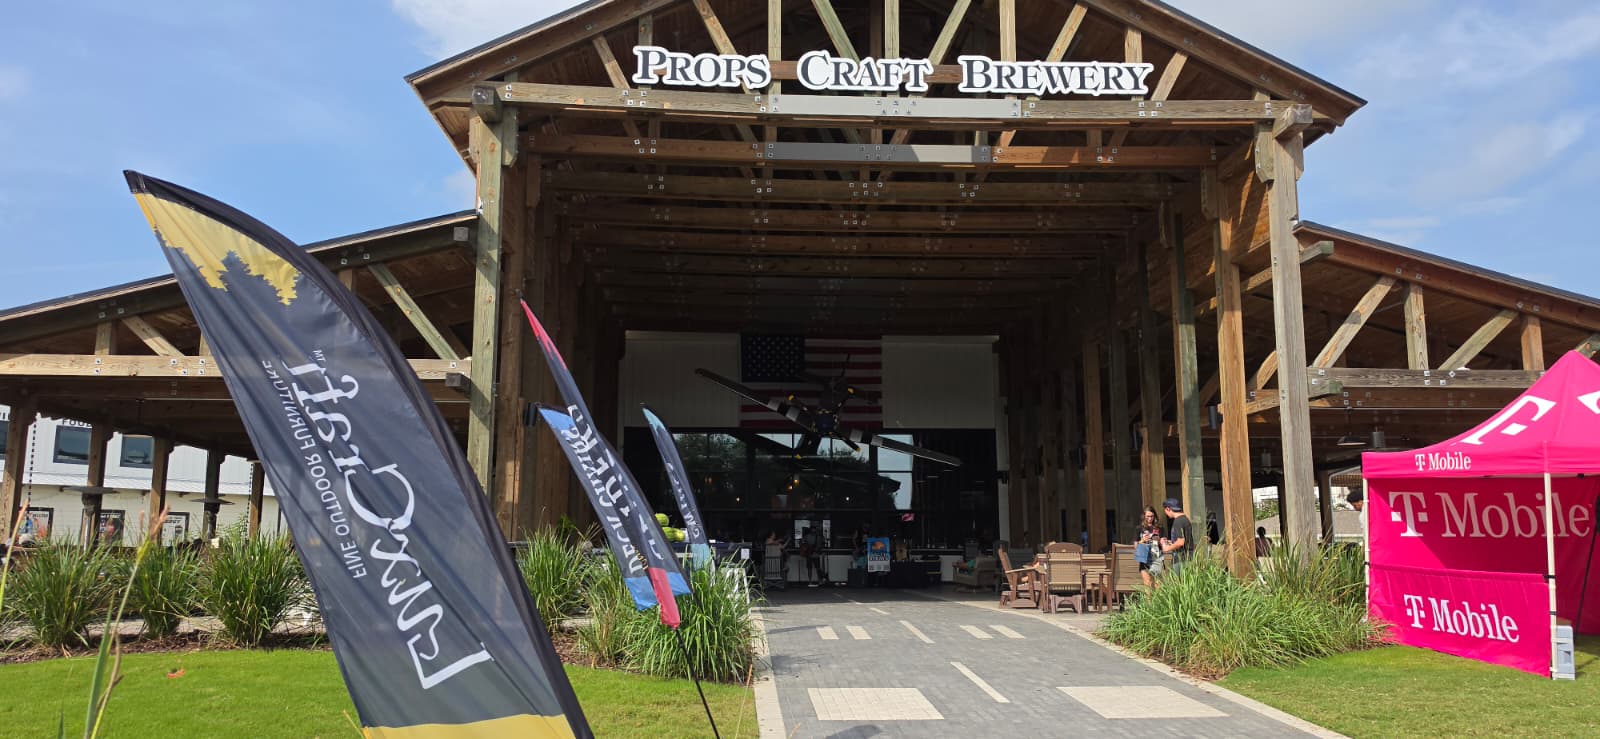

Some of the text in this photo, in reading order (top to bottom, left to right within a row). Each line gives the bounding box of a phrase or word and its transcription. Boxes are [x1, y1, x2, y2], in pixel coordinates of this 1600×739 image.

[635, 48, 1150, 94] PROPS CRAFT BREWERY
[1428, 452, 1472, 470] Mobile
[1435, 492, 1590, 538] Mobile
[1428, 597, 1520, 643] Mobile
